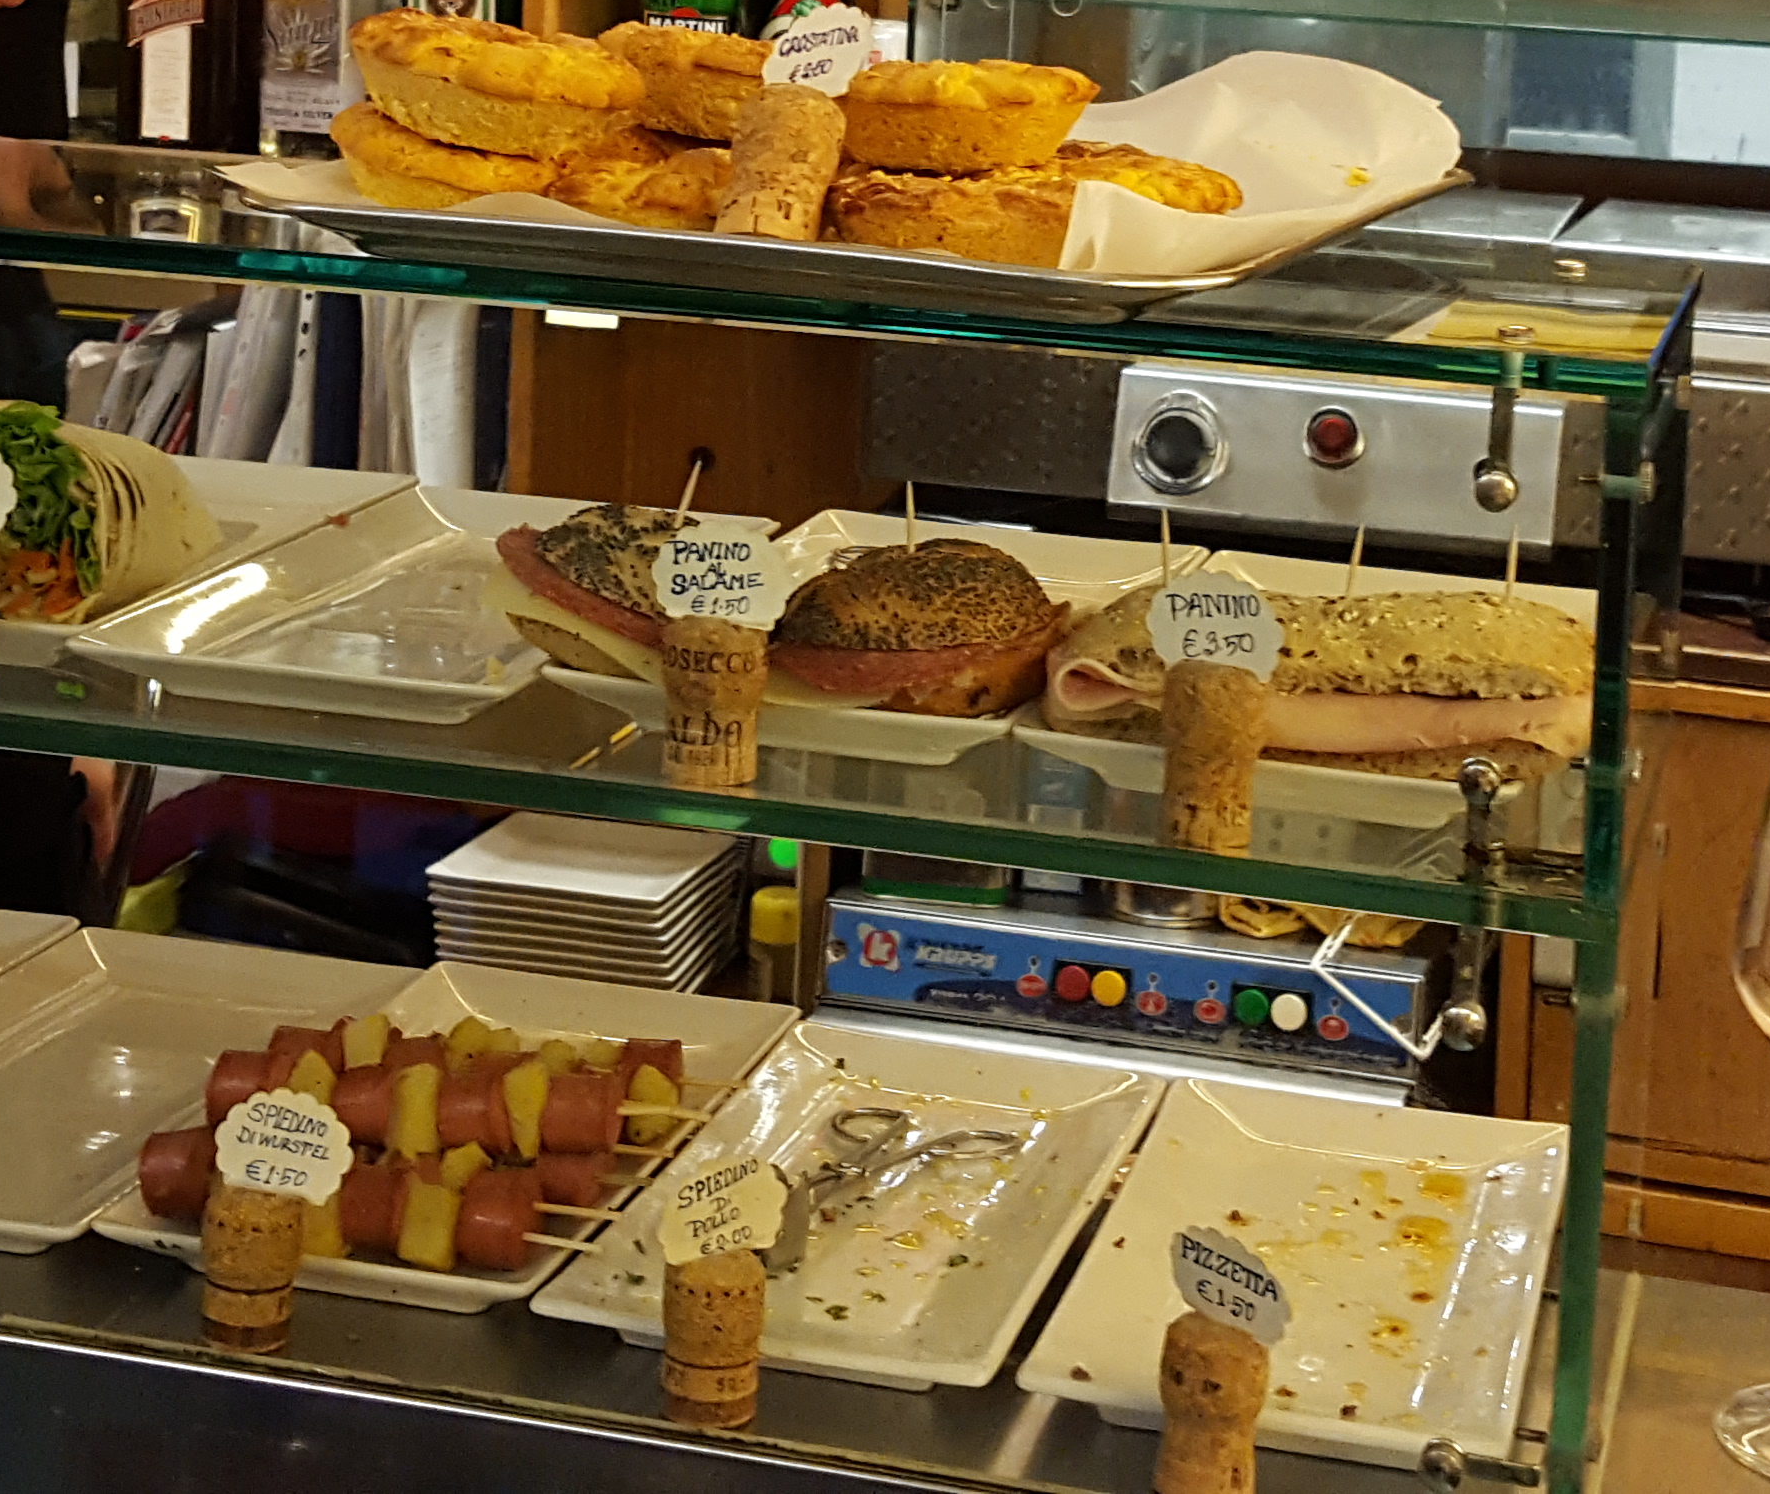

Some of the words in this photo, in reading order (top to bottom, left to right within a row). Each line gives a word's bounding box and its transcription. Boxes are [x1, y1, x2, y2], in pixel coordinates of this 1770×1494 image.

[667, 540, 752, 566] PANINO
[670, 572, 765, 596] SALAME
[1165, 592, 1261, 621] PANINO
[247, 1102, 328, 1138] SPIEDINO
[677, 1158, 759, 1209] SPIEDINO
[685, 1208, 742, 1238] POLLO
[1181, 1233, 1278, 1303] PIZZETTA
